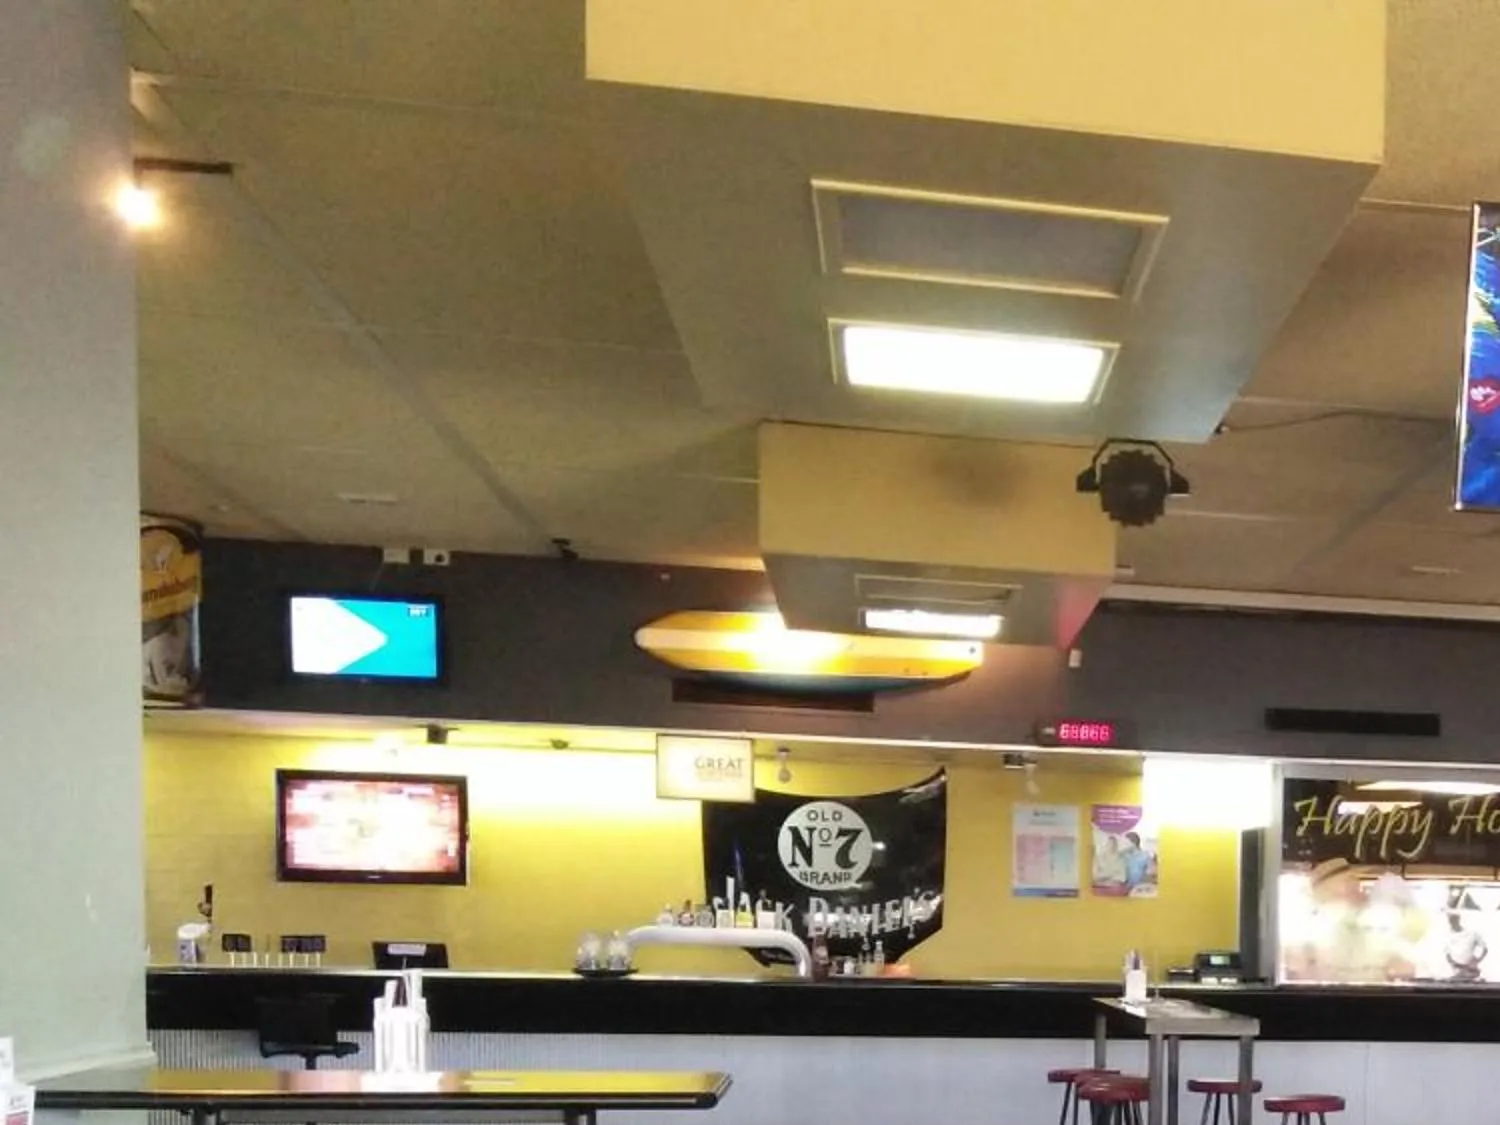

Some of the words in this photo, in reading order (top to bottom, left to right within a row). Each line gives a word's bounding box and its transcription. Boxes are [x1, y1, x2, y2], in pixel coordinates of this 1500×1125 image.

[807, 809, 843, 822] OLD
[1294, 795, 1434, 858] Happy
[800, 871, 852, 885] BRAND
